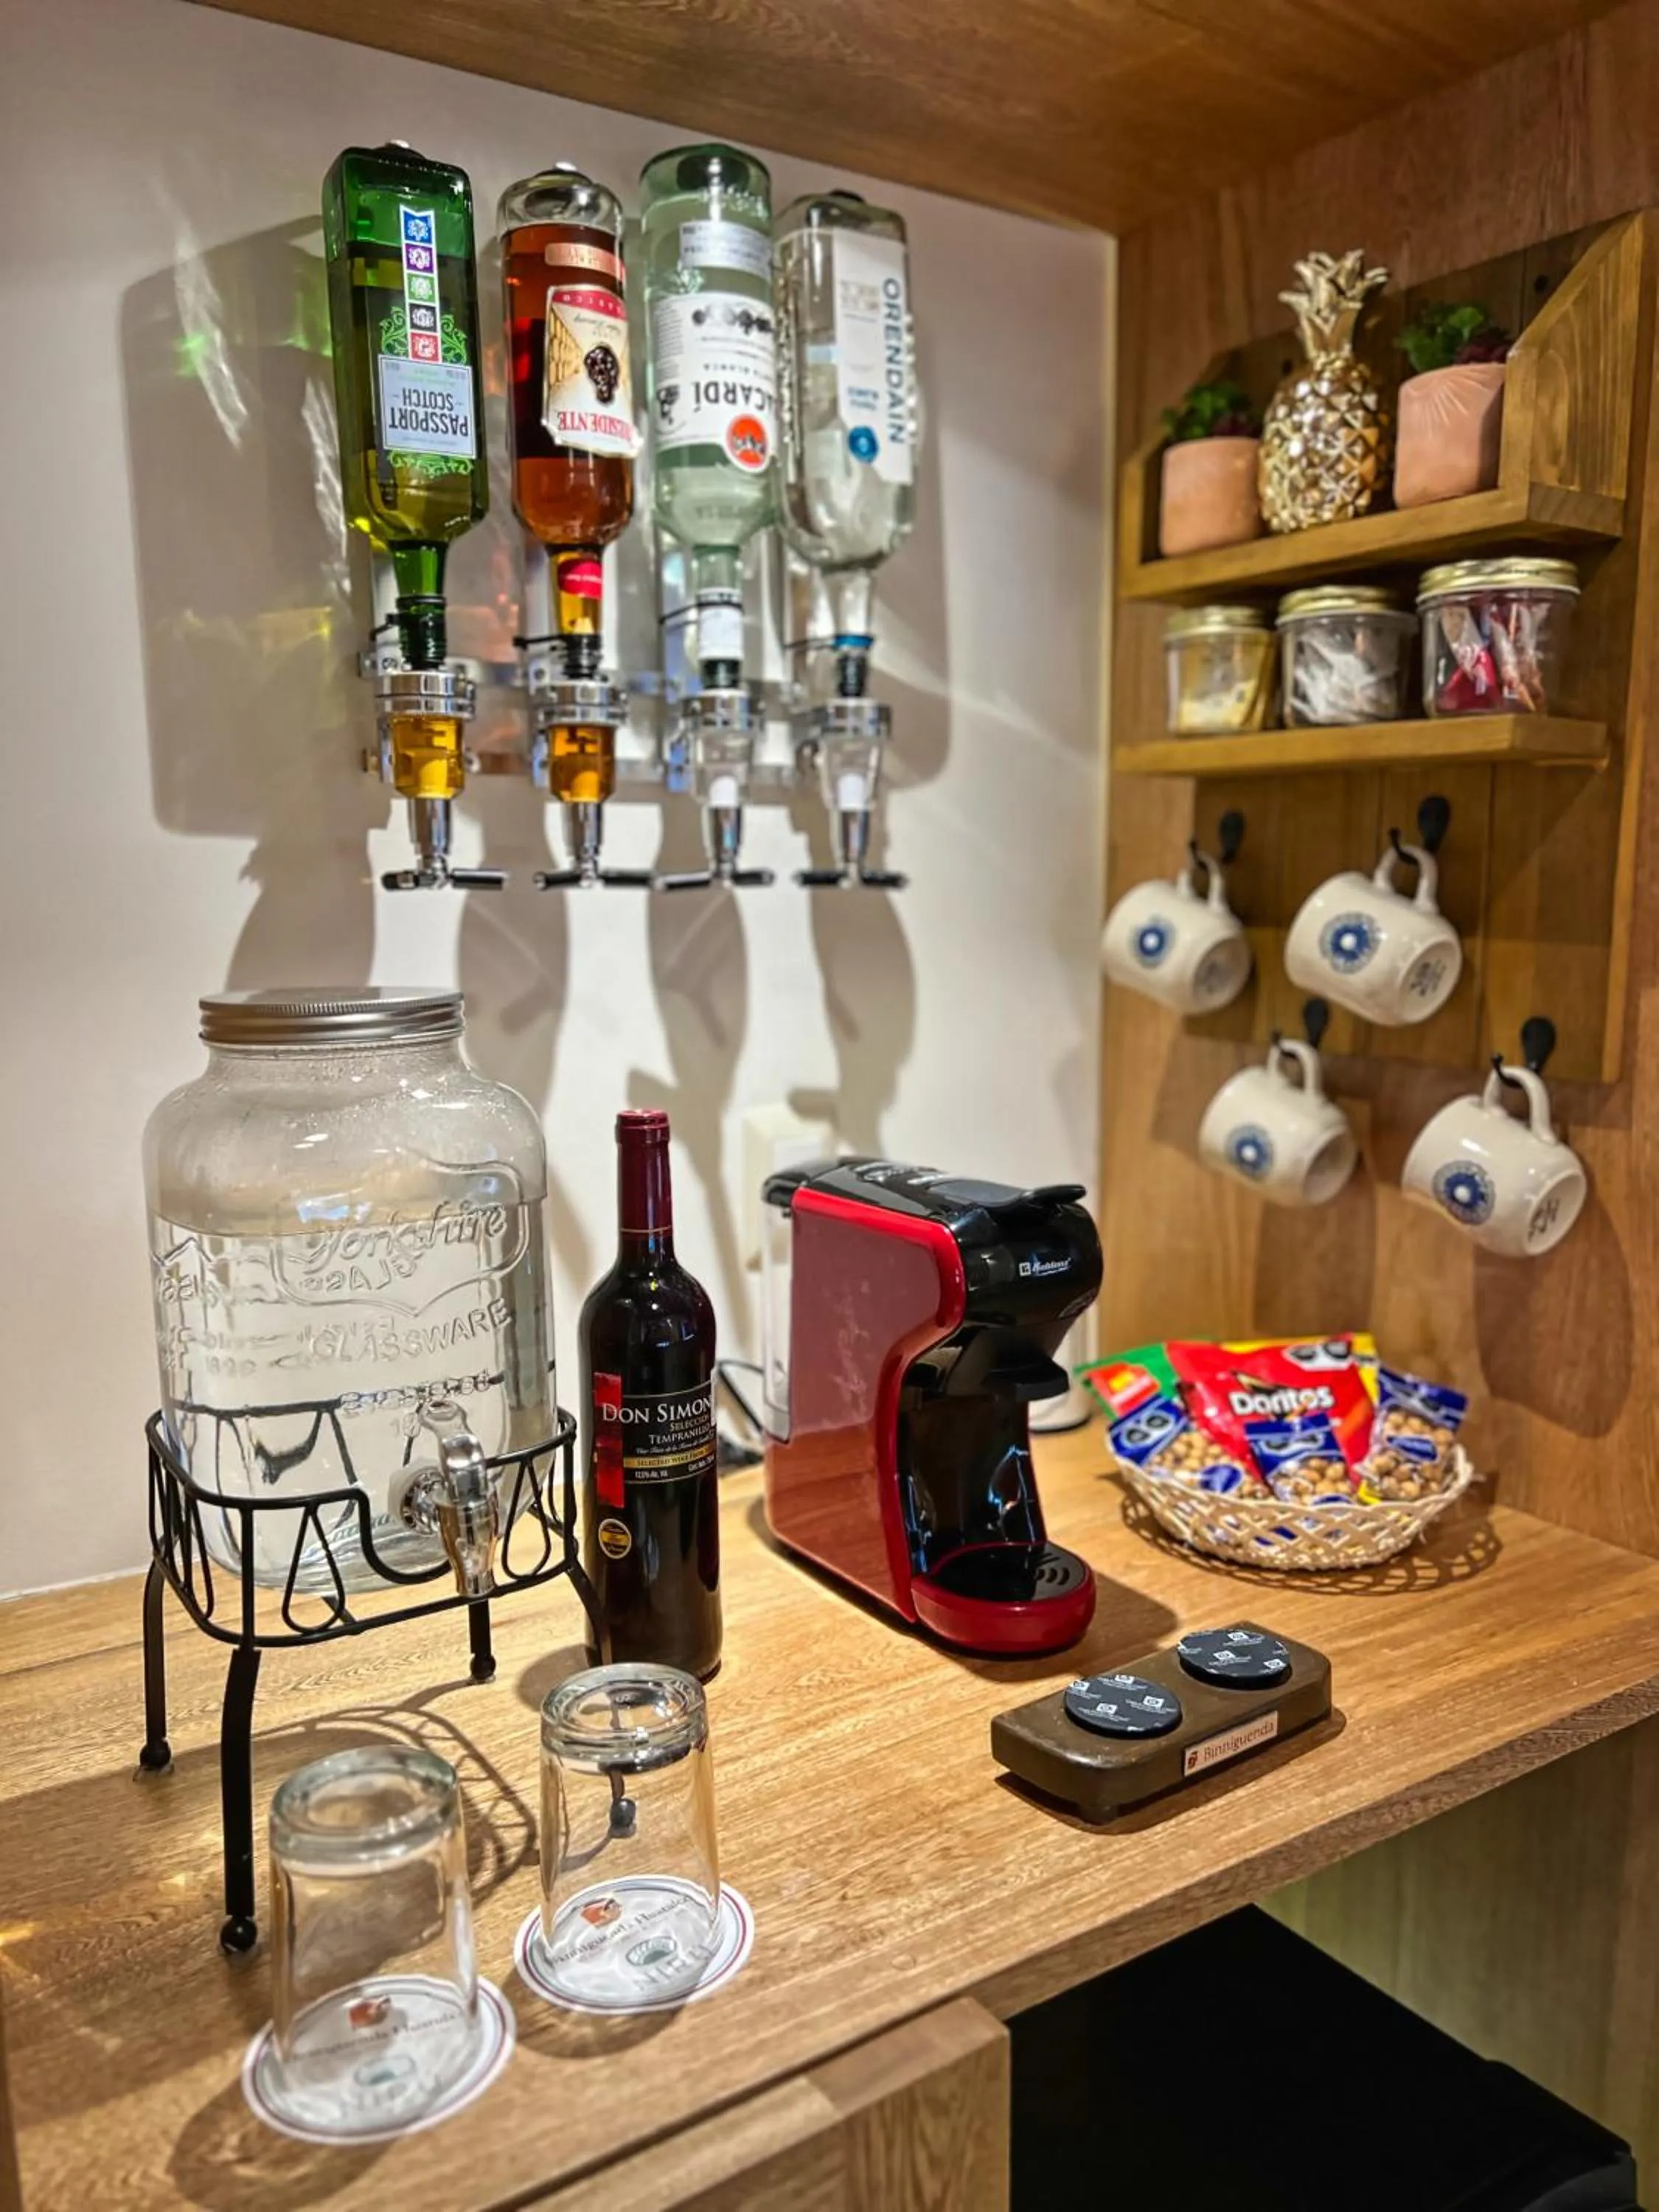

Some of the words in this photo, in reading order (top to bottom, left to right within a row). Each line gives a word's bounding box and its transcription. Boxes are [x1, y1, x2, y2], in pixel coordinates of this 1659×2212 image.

[882, 277, 905, 445] ORENDAIN
[402, 387, 454, 411] SCOTCH
[693, 380, 775, 413] ACARDÍ
[389, 406, 469, 437] PASSPORT
[309, 1298, 514, 1362] GLASSWARE
[1228, 1385, 1335, 1416] Doritos
[1204, 1720, 1274, 1761] Binniguenda
